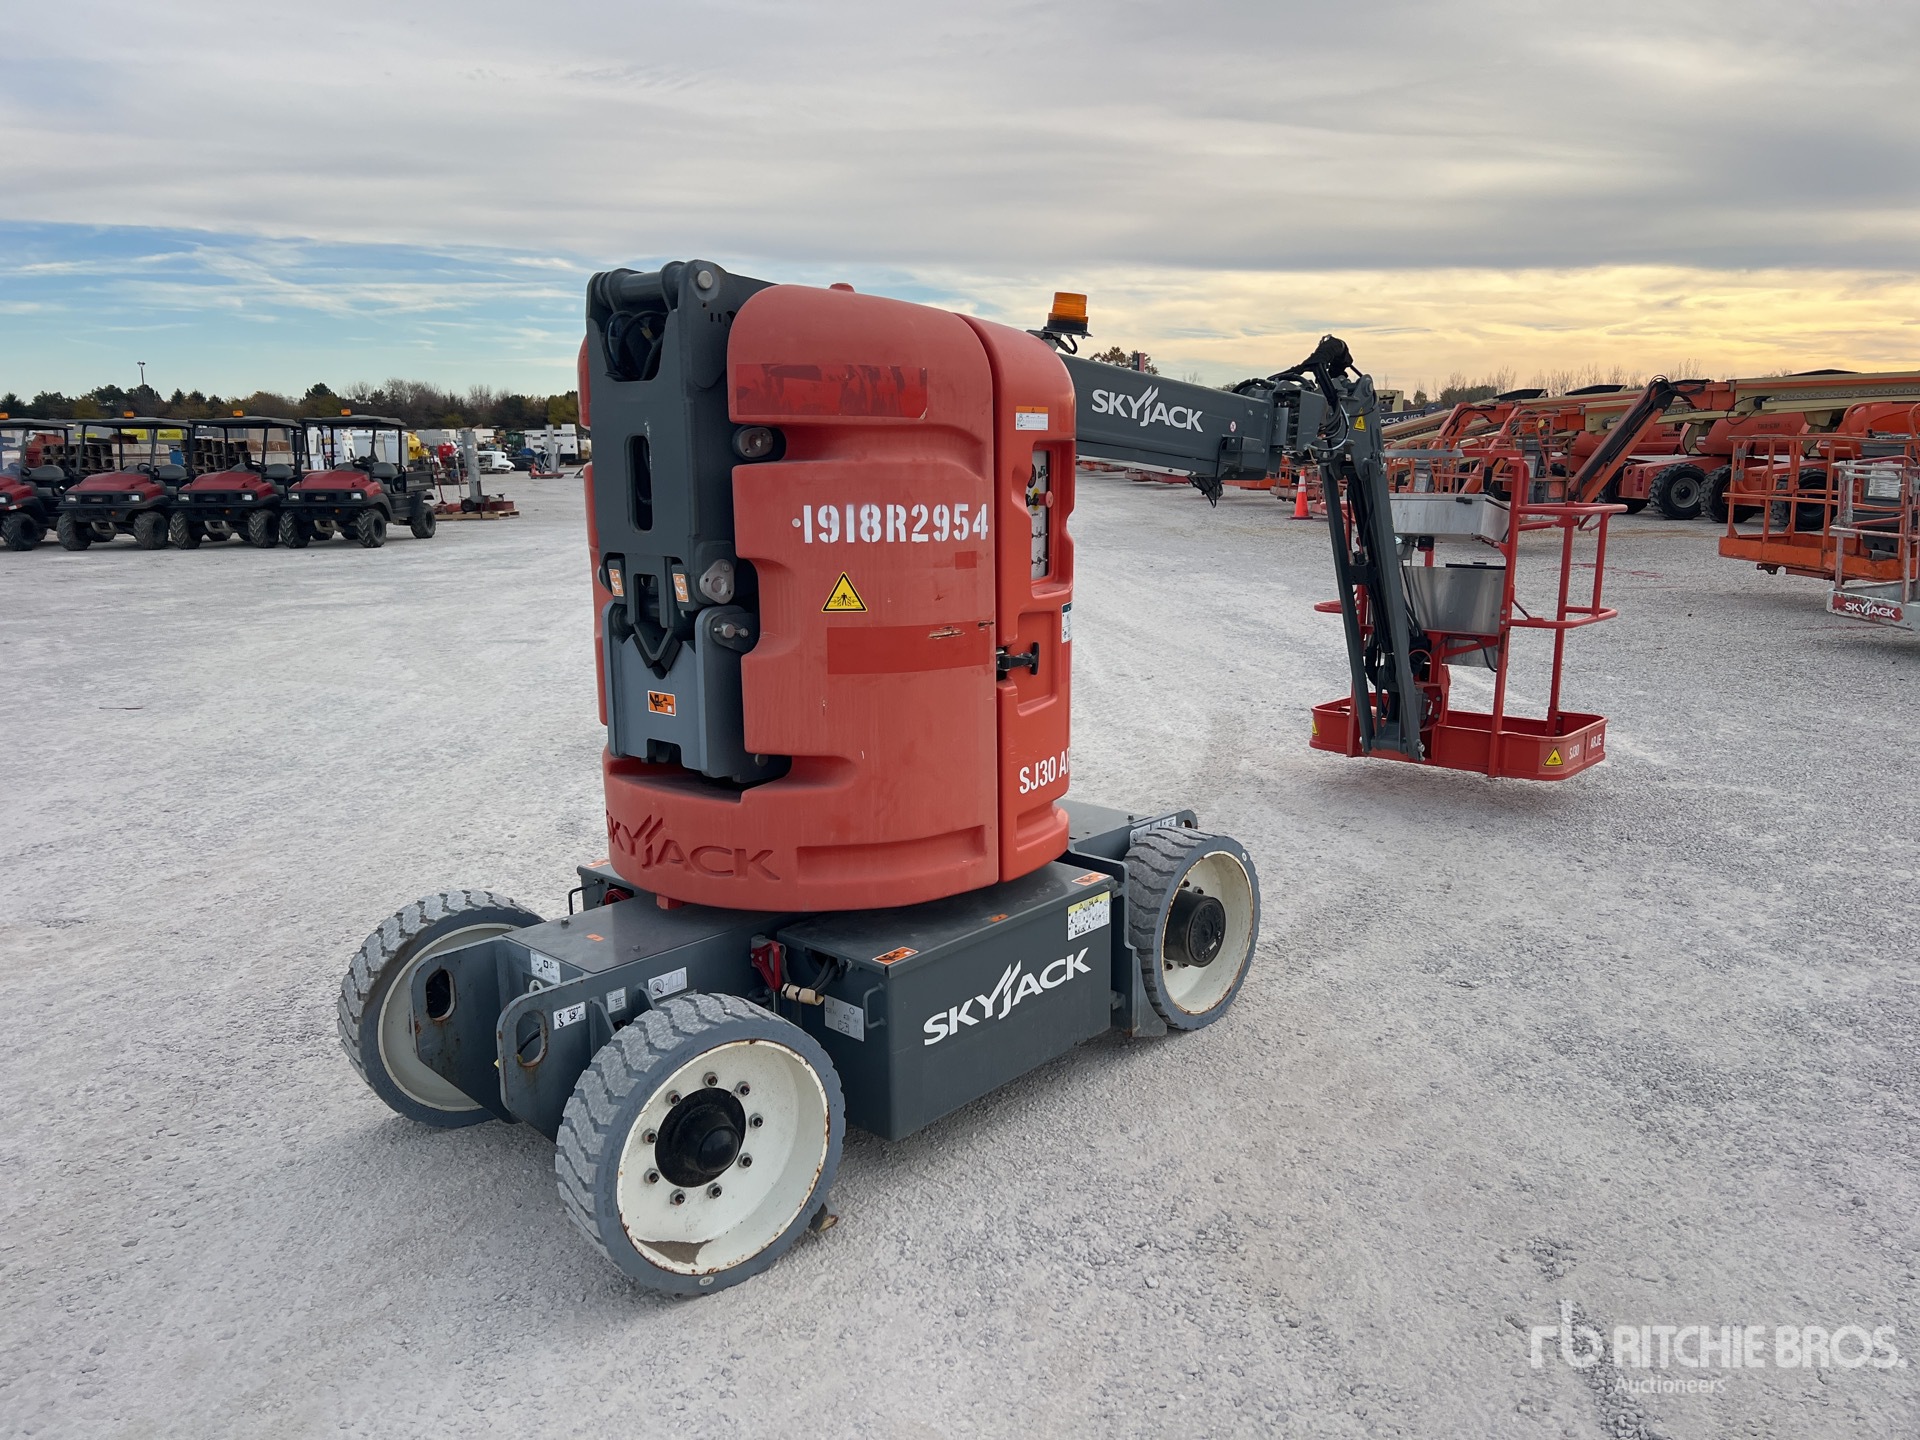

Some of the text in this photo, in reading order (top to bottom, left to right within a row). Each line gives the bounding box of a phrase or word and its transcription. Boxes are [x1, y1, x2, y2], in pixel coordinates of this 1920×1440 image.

[1091, 384, 1204, 433] SKYJACK
[803, 503, 989, 543] 1918R2954
[1845, 600, 1896, 618] SKYJACK
[1019, 755, 1057, 794] SJ30
[923, 947, 1092, 1046] SKYJACK
